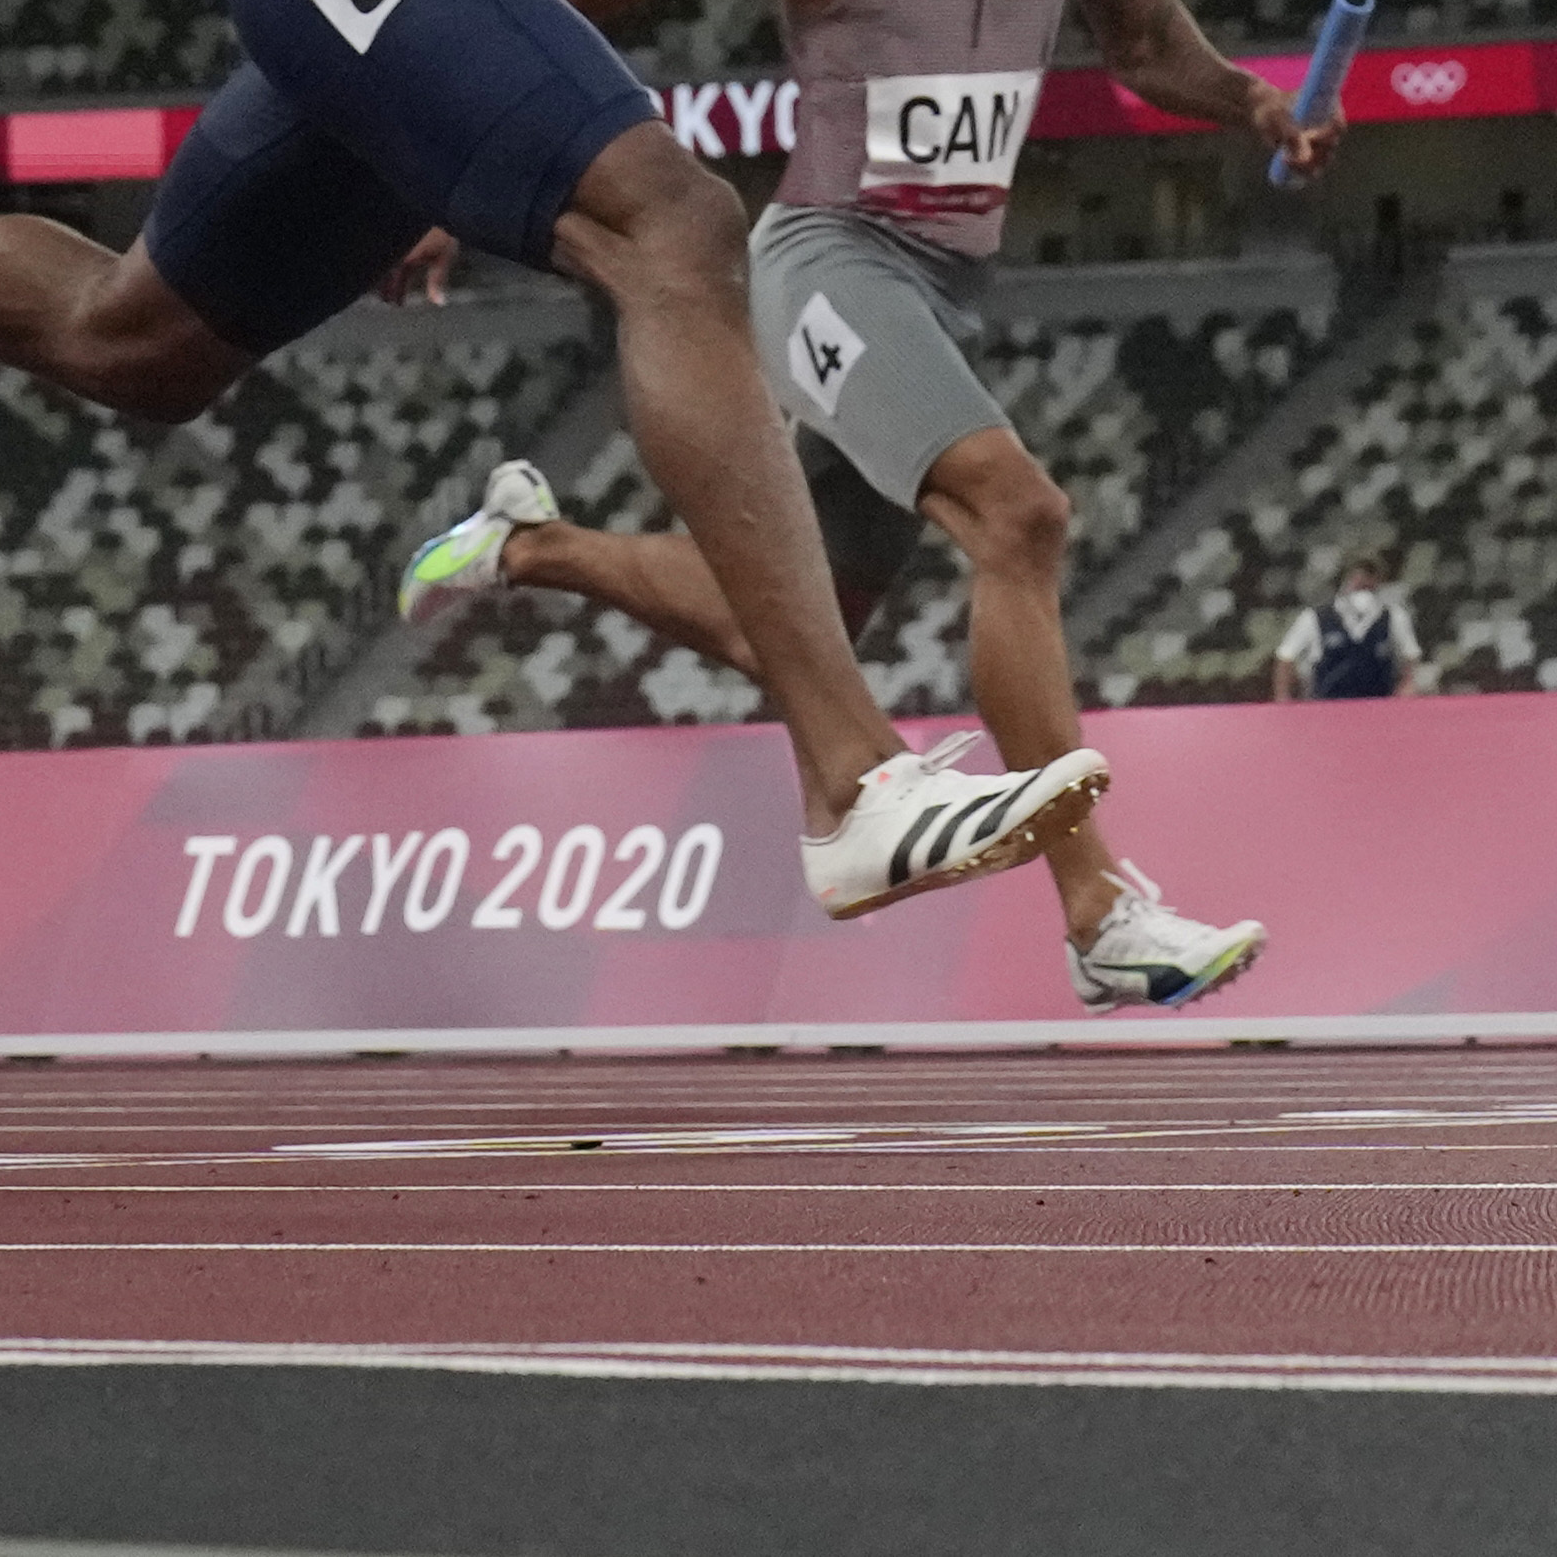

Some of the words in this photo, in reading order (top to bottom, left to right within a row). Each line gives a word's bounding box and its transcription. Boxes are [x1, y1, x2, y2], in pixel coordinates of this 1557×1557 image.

[899, 90, 1020, 164] CAN
[802, 325, 842, 385] 4
[175, 826, 471, 939] TOKYO
[471, 822, 725, 931] 2020
